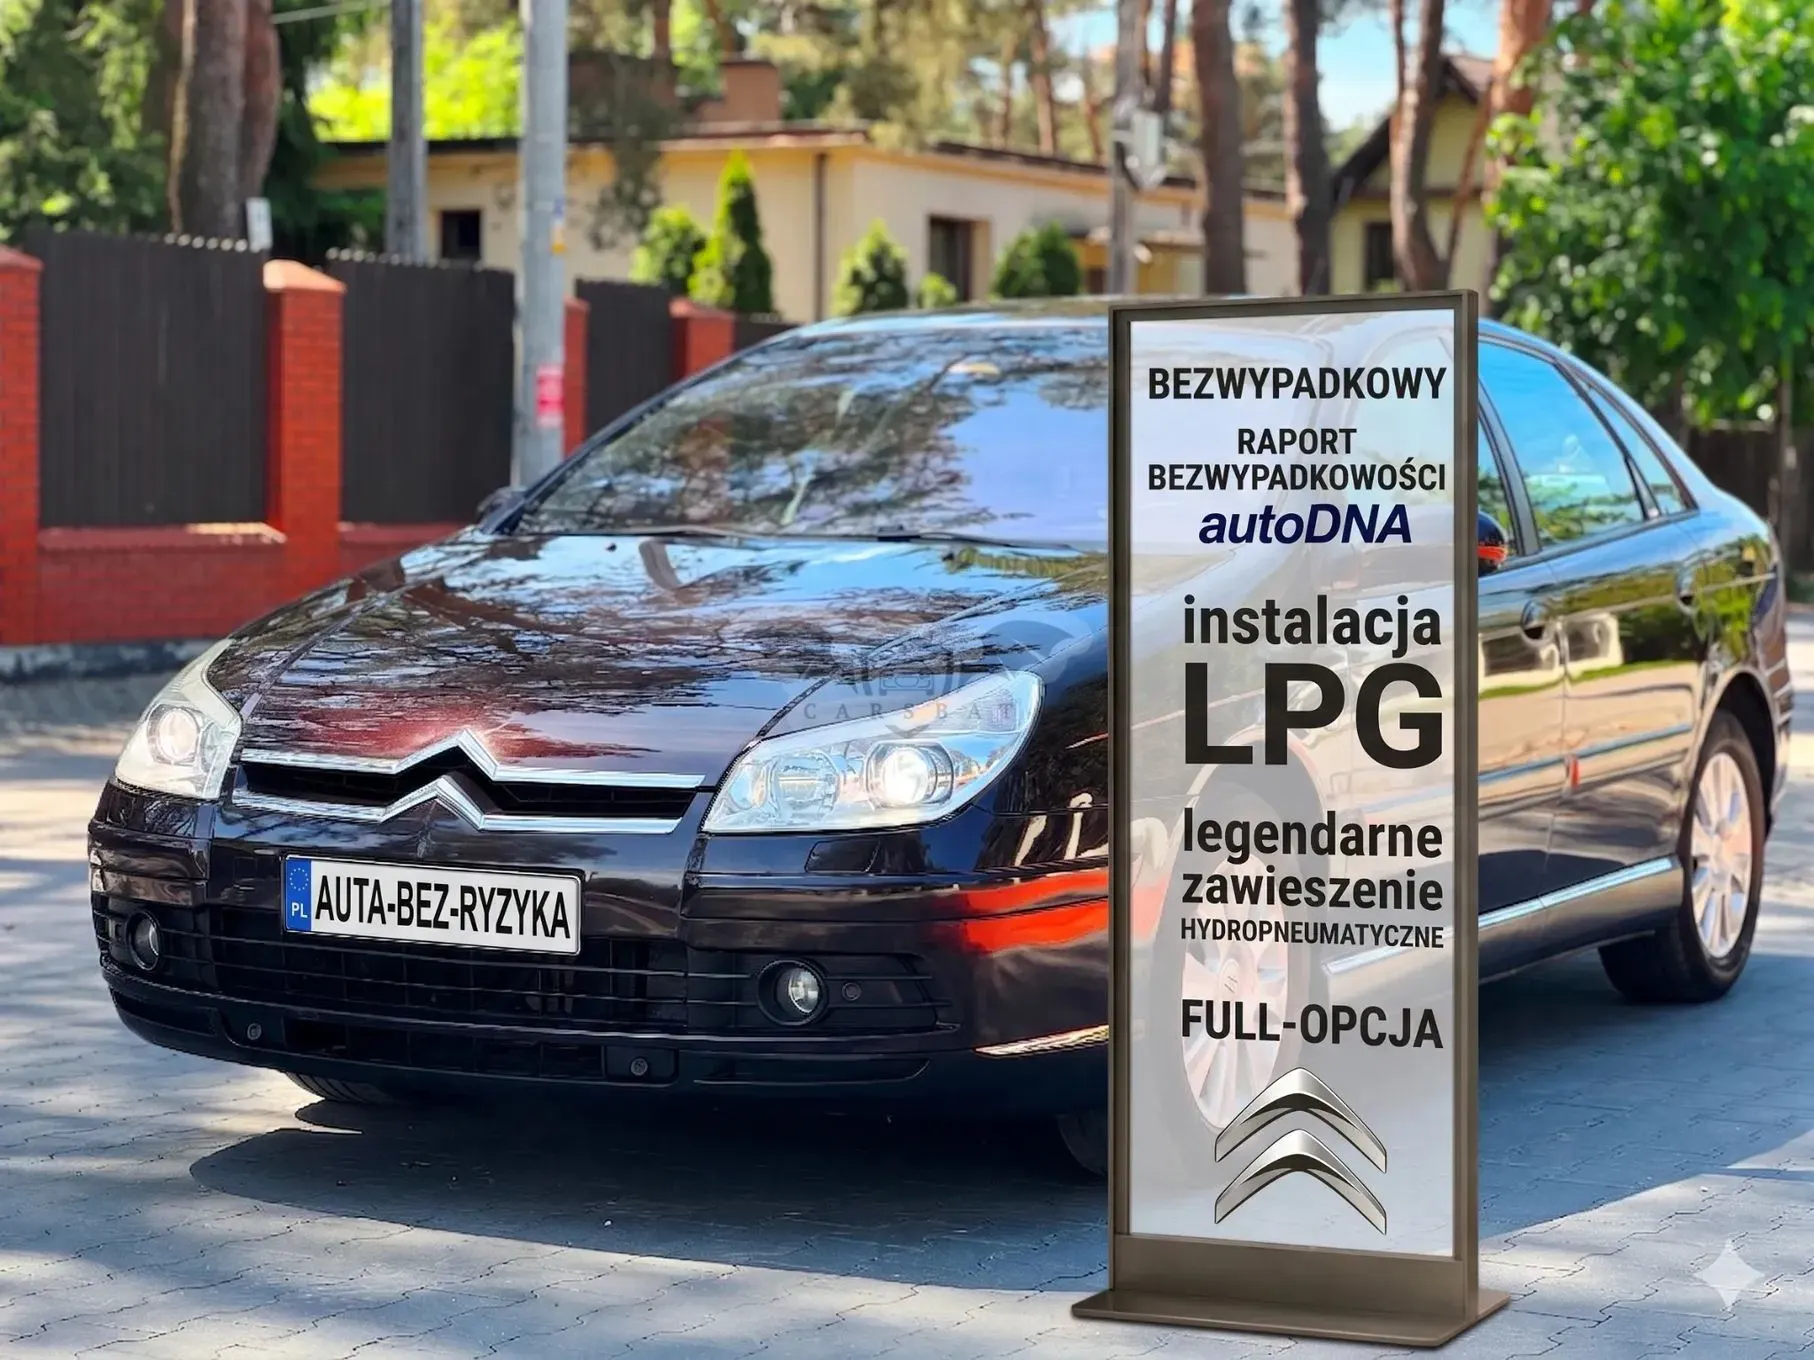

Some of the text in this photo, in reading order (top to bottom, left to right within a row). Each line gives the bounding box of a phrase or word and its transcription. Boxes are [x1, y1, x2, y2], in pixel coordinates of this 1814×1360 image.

[1148, 367, 1447, 400] BEZWYPADKOWY
[1237, 428, 1357, 455] RAPORT
[1148, 457, 1446, 491] BEZWYPADKOWOŚCI
[1198, 503, 1412, 544] autoDNA
[1184, 594, 1442, 659] instalacja
[1184, 662, 1443, 769] LPG
[1183, 807, 1443, 865] legendarne
[314, 874, 571, 939] AUTA-BEZ-RYZYKA
[1182, 865, 1444, 911] zawieszenie
[291, 902, 308, 919] PL
[1181, 918, 1444, 949] HYDROPNEUMATYCZNE
[1181, 998, 1444, 1049] FULL-OPCJA
